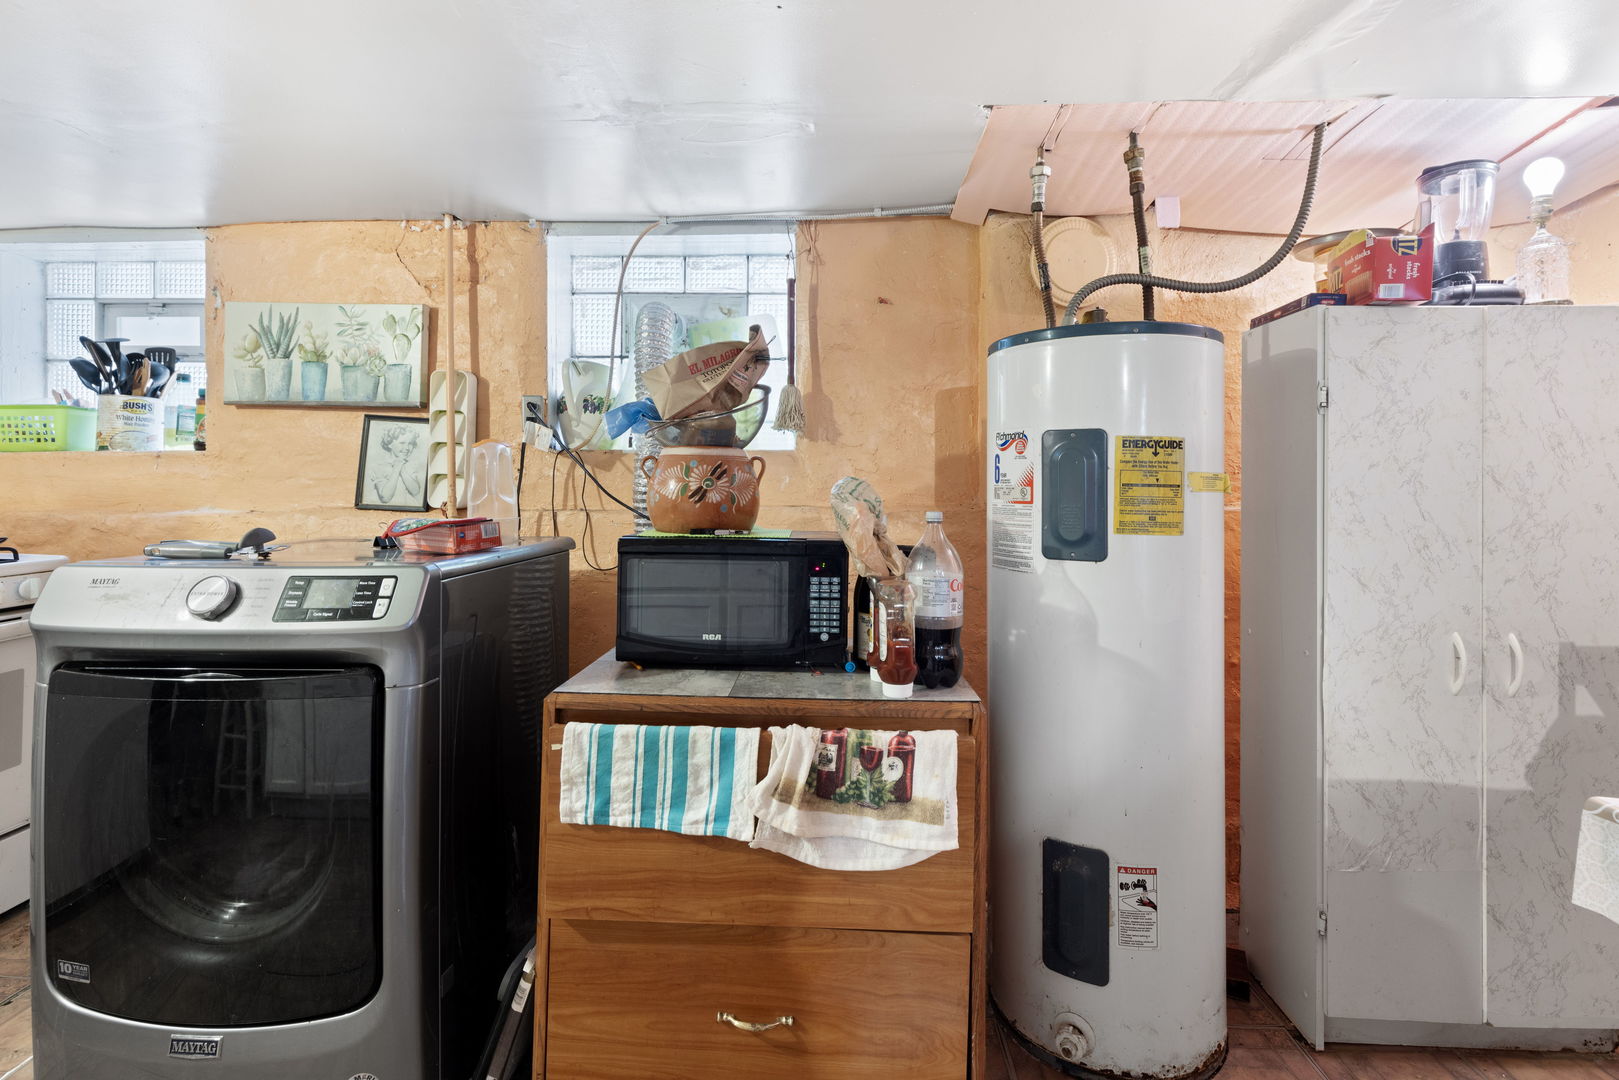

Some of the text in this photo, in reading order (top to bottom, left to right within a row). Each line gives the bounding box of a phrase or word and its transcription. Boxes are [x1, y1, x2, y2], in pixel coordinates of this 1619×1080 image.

[688, 362, 703, 376] EL
[116, 414, 135, 422] White
[996, 430, 1025, 442] Richmond
[1122, 439, 1183, 450] ENERGYGUIDE
[994, 453, 1001, 484] 6
[702, 633, 722, 641] RCA
[1127, 867, 1155, 875] DANGER
[60, 962, 73, 974] 10
[72, 964, 88, 972] YEAR
[171, 1041, 216, 1055] MAYTAG
